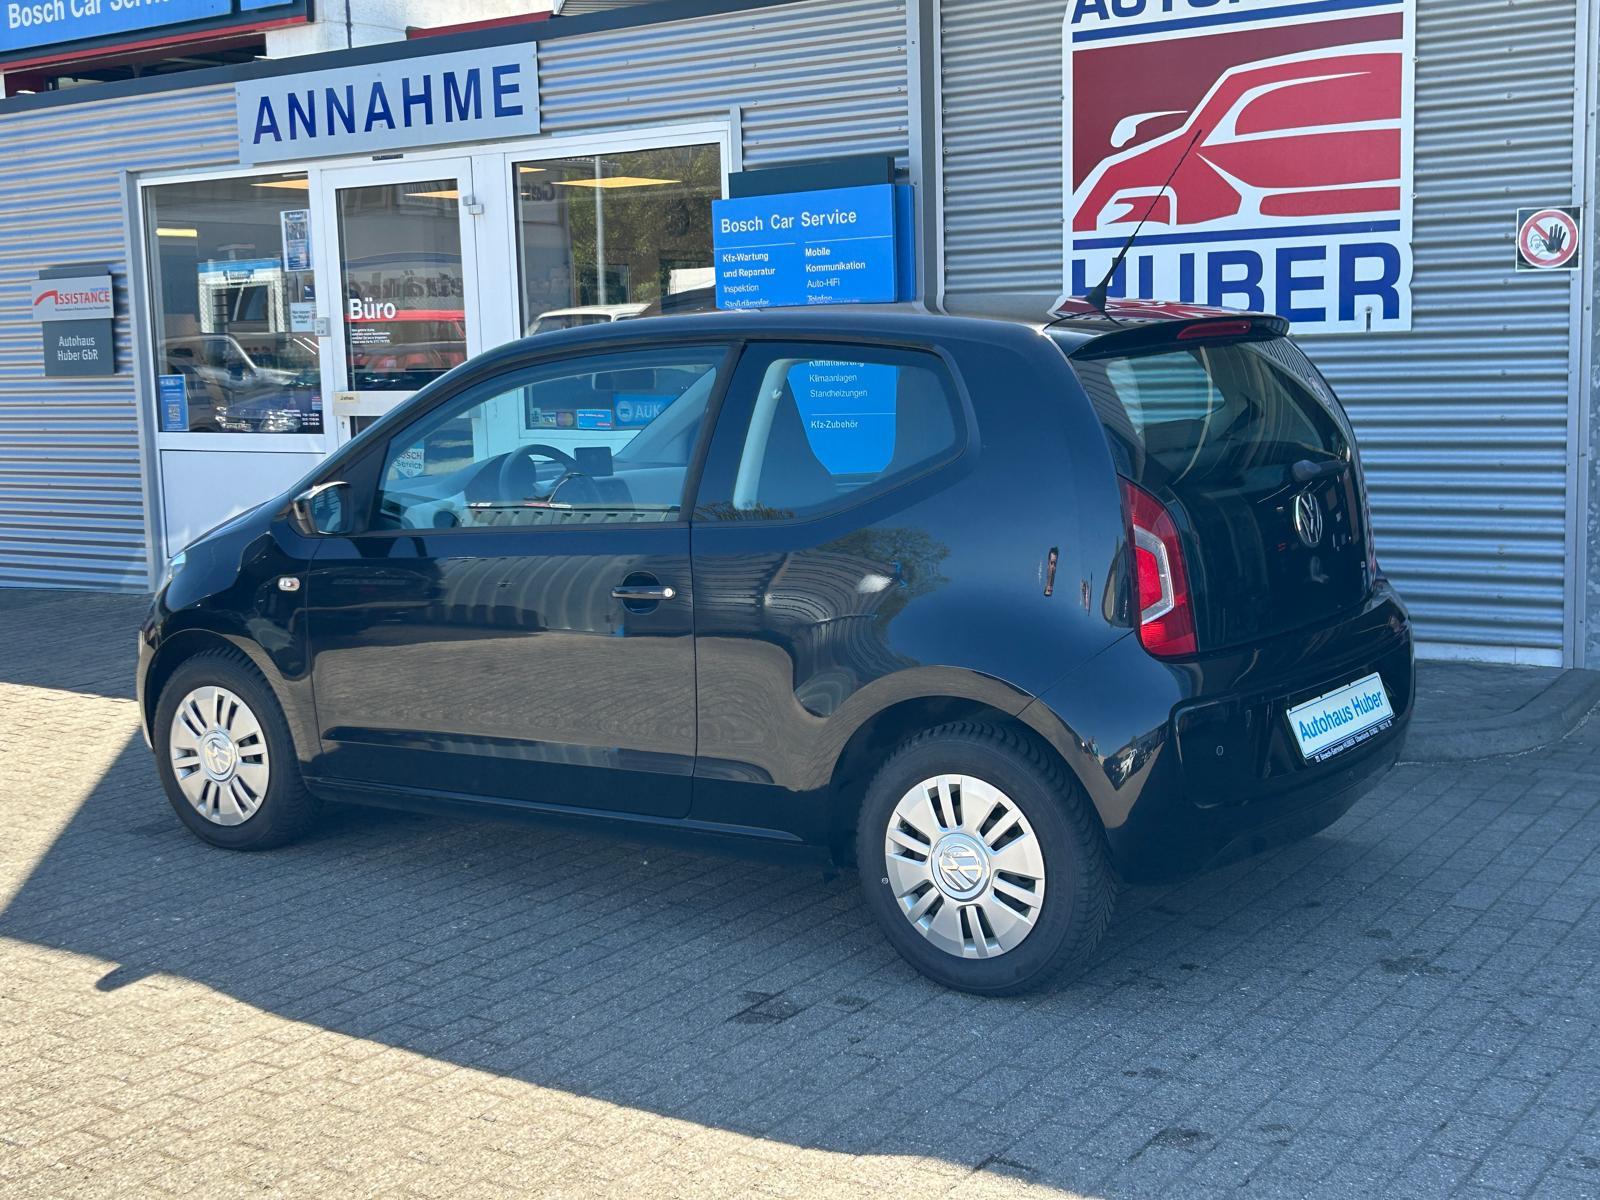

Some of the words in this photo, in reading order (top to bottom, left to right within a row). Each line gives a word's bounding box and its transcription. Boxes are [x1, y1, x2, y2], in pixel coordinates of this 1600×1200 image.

[8, 2, 65, 29] Bosch
[70, 0, 101, 18] Car
[253, 63, 523, 144] ANNAHME
[721, 216, 764, 233] Bosch
[771, 214, 794, 229] Car
[801, 209, 857, 227] Service
[723, 252, 769, 263] Kfz-Wartung
[805, 247, 831, 257] Mobile
[723, 269, 738, 278] und
[739, 267, 776, 278] Reparatur
[806, 261, 866, 273] Kommunikation
[807, 278, 841, 288] Auto-HiFi
[724, 285, 760, 294] Inspektion
[349, 297, 396, 320] Büro
[58, 336, 96, 347] Autohaus
[57, 350, 81, 361] Huber
[82, 349, 99, 361] GbR
[809, 374, 858, 384] Klimaanlagen
[810, 389, 868, 399] Standheizungen
[811, 419, 859, 429] Kfz-Zubehör
[1299, 705, 1354, 742] Autohaus
[1351, 690, 1384, 718] Huber
